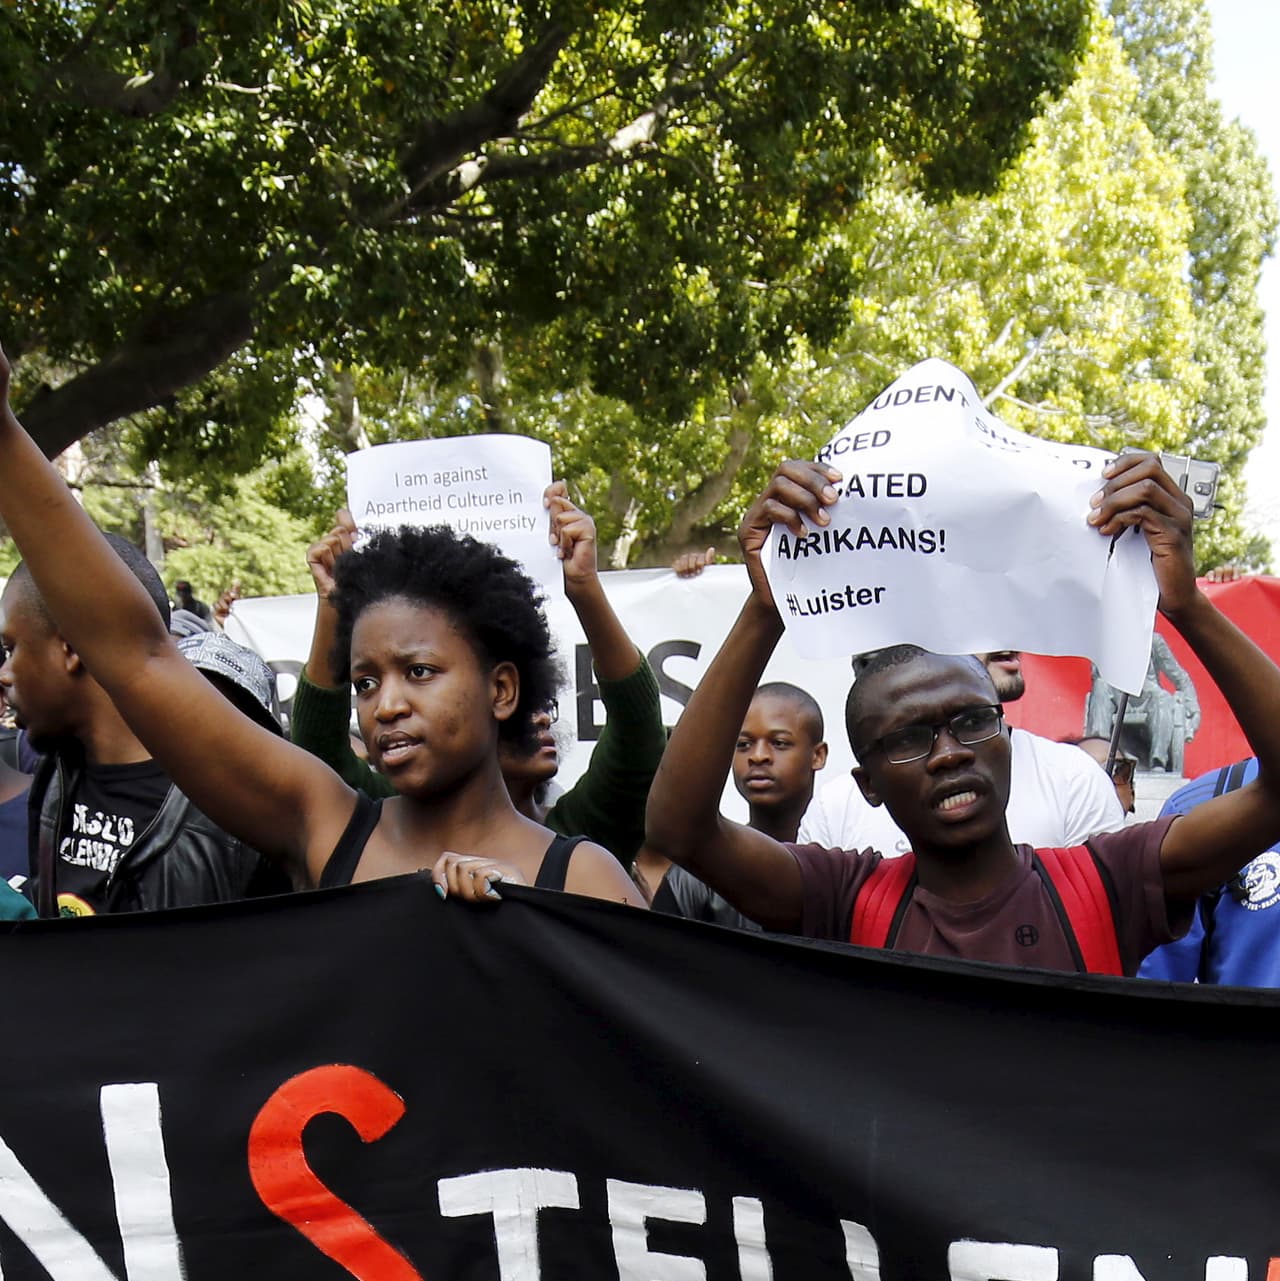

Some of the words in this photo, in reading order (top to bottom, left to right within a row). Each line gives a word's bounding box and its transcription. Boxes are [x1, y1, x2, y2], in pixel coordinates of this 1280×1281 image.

[404, 474, 428, 487] am
[433, 466, 488, 487] against
[365, 495, 442, 516] Apartheid
[447, 492, 504, 508] Culture
[508, 490, 523, 504] in
[458, 514, 537, 533] University
[778, 526, 946, 560] AFRIKAANS!
[786, 585, 886, 616] #Luister
